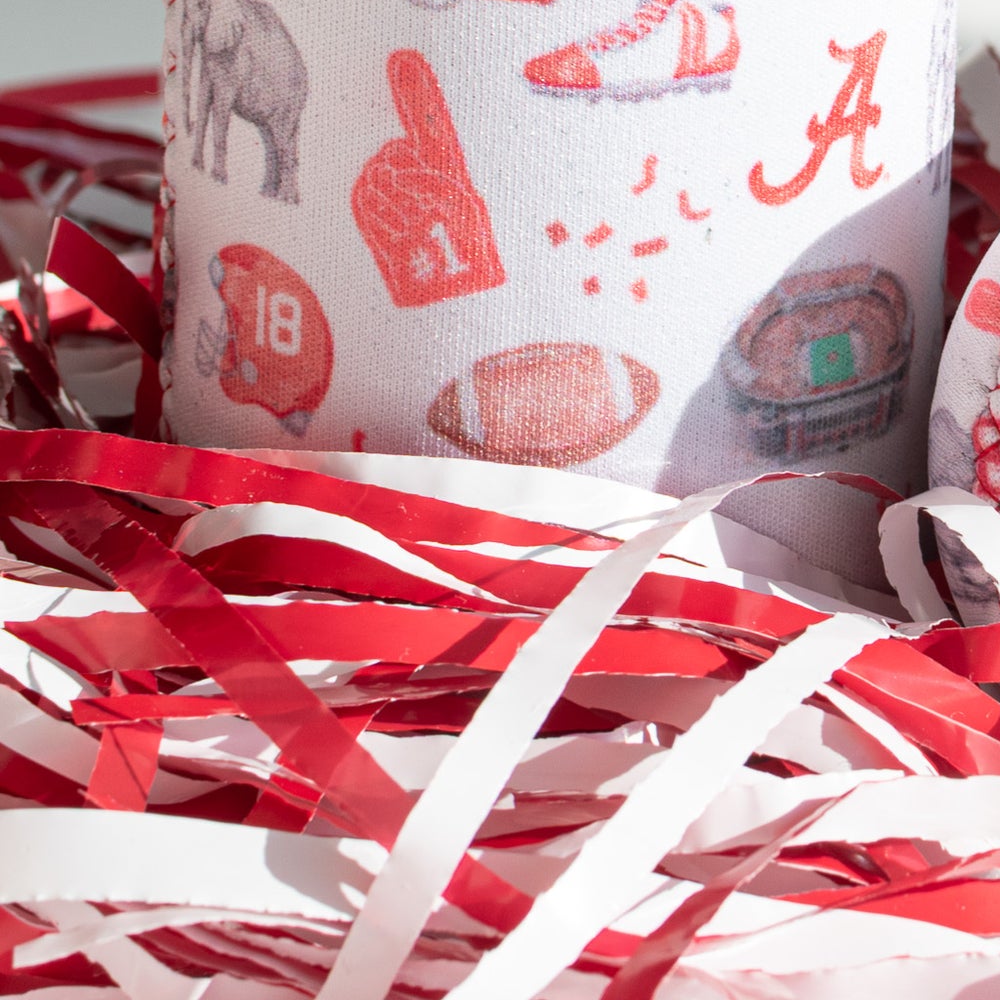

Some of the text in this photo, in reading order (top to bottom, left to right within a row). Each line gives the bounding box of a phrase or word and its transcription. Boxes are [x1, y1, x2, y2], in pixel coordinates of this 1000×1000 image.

[748, 28, 886, 207] A
[409, 220, 470, 282] #1
[255, 285, 302, 357] 18
